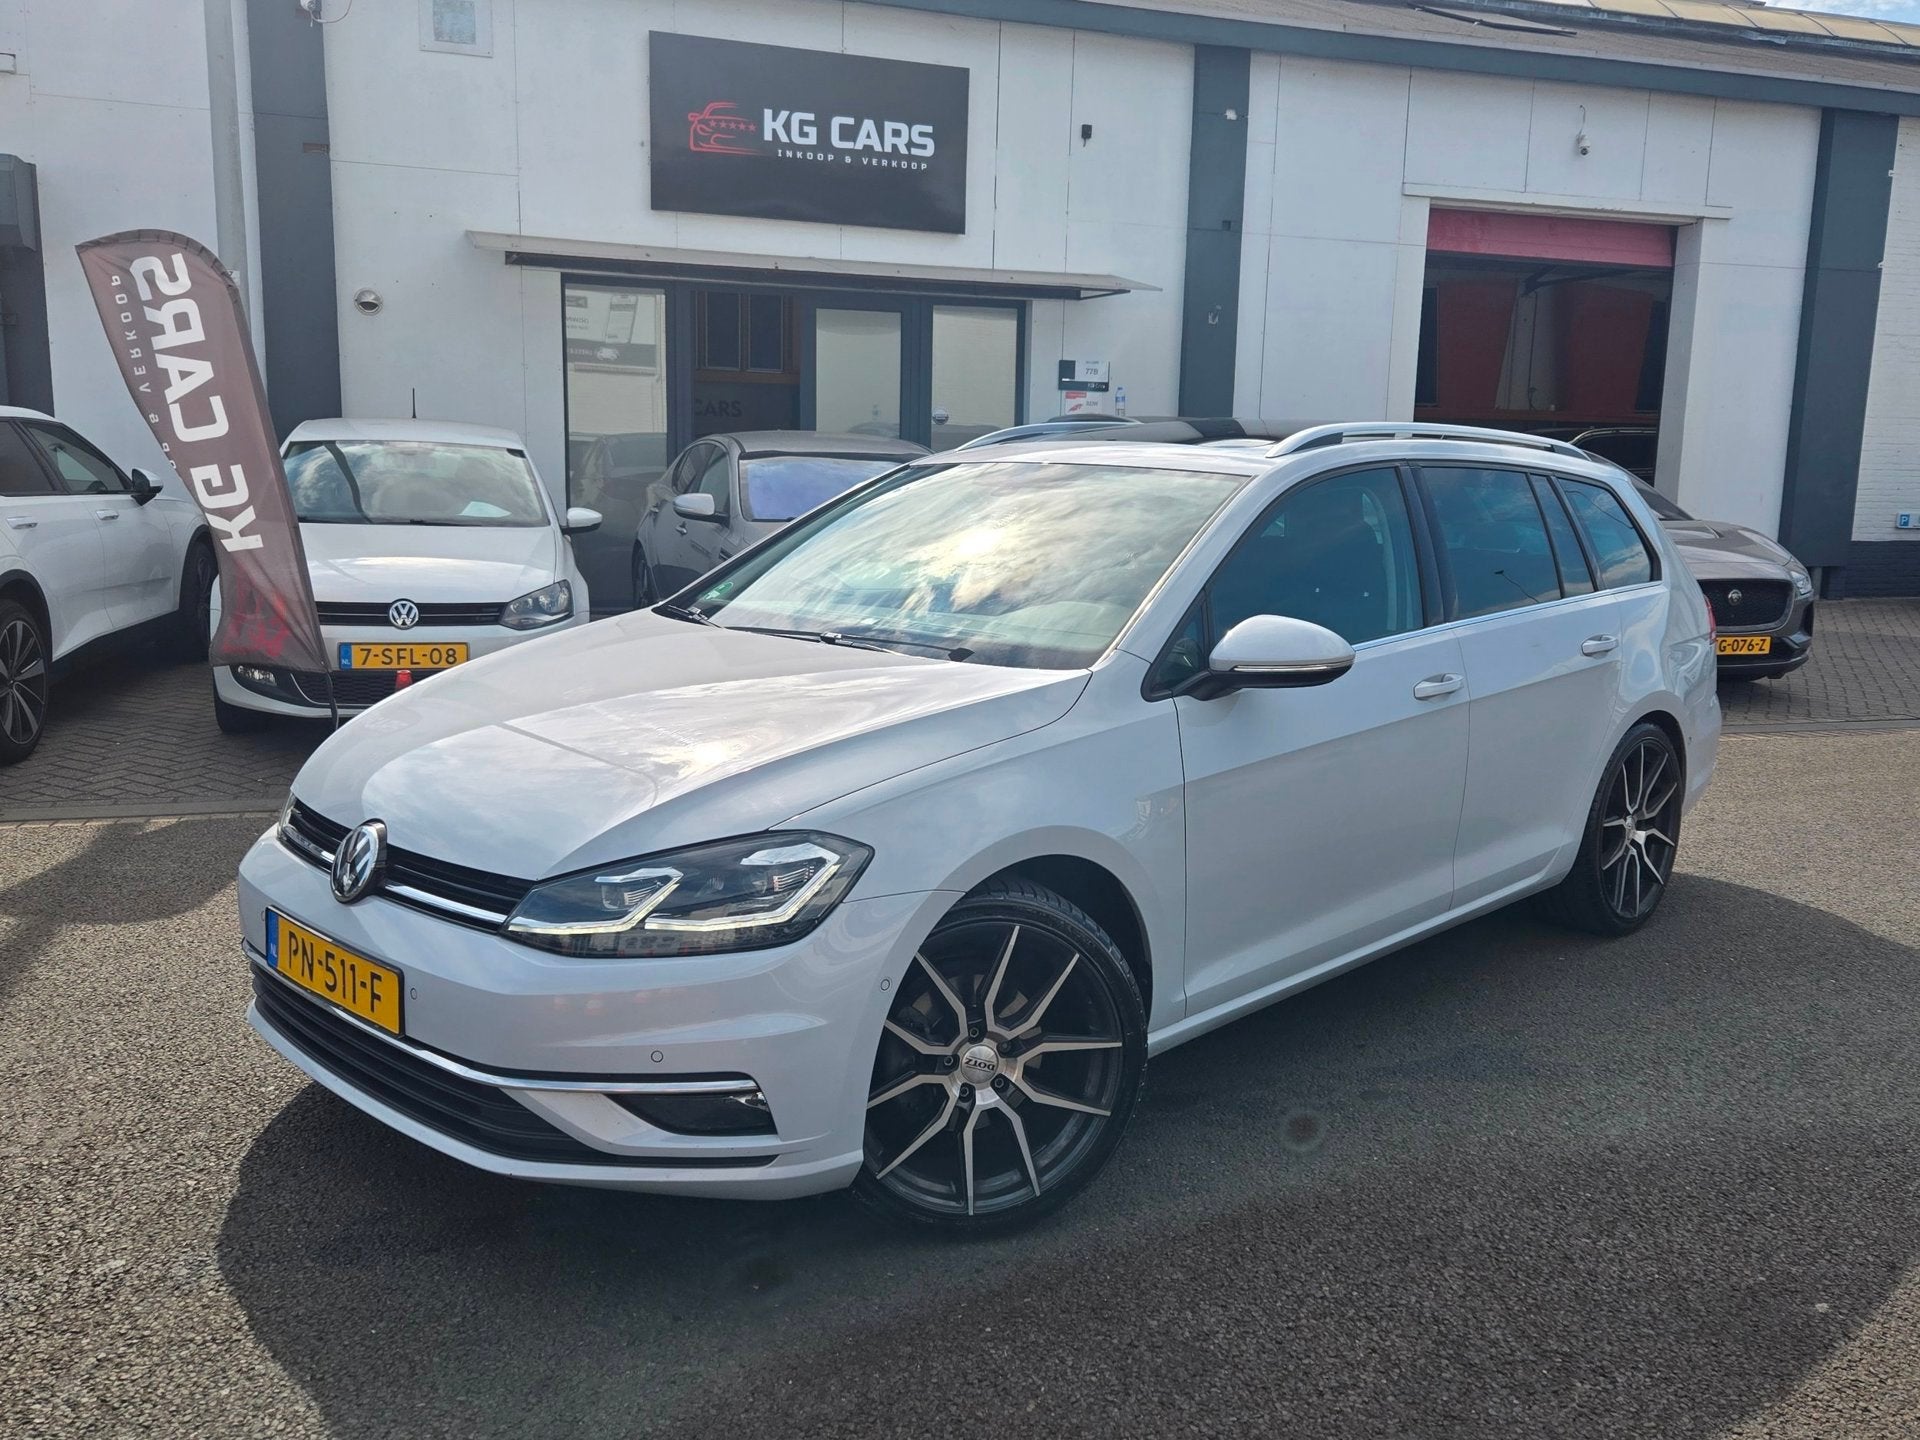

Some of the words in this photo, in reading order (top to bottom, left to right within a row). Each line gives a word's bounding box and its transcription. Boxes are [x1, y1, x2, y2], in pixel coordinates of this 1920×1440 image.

[763, 108, 818, 146] KG
[830, 115, 936, 158] CARS
[777, 149, 835, 163] INKOOP
[844, 155, 852, 164] &
[862, 157, 928, 171] VERKOOP
[1716, 639, 1767, 652] G-076-Z
[360, 647, 458, 667] 7-SFL-08
[288, 930, 383, 1014] PN-511-F
[964, 1057, 995, 1071] DOTZ
